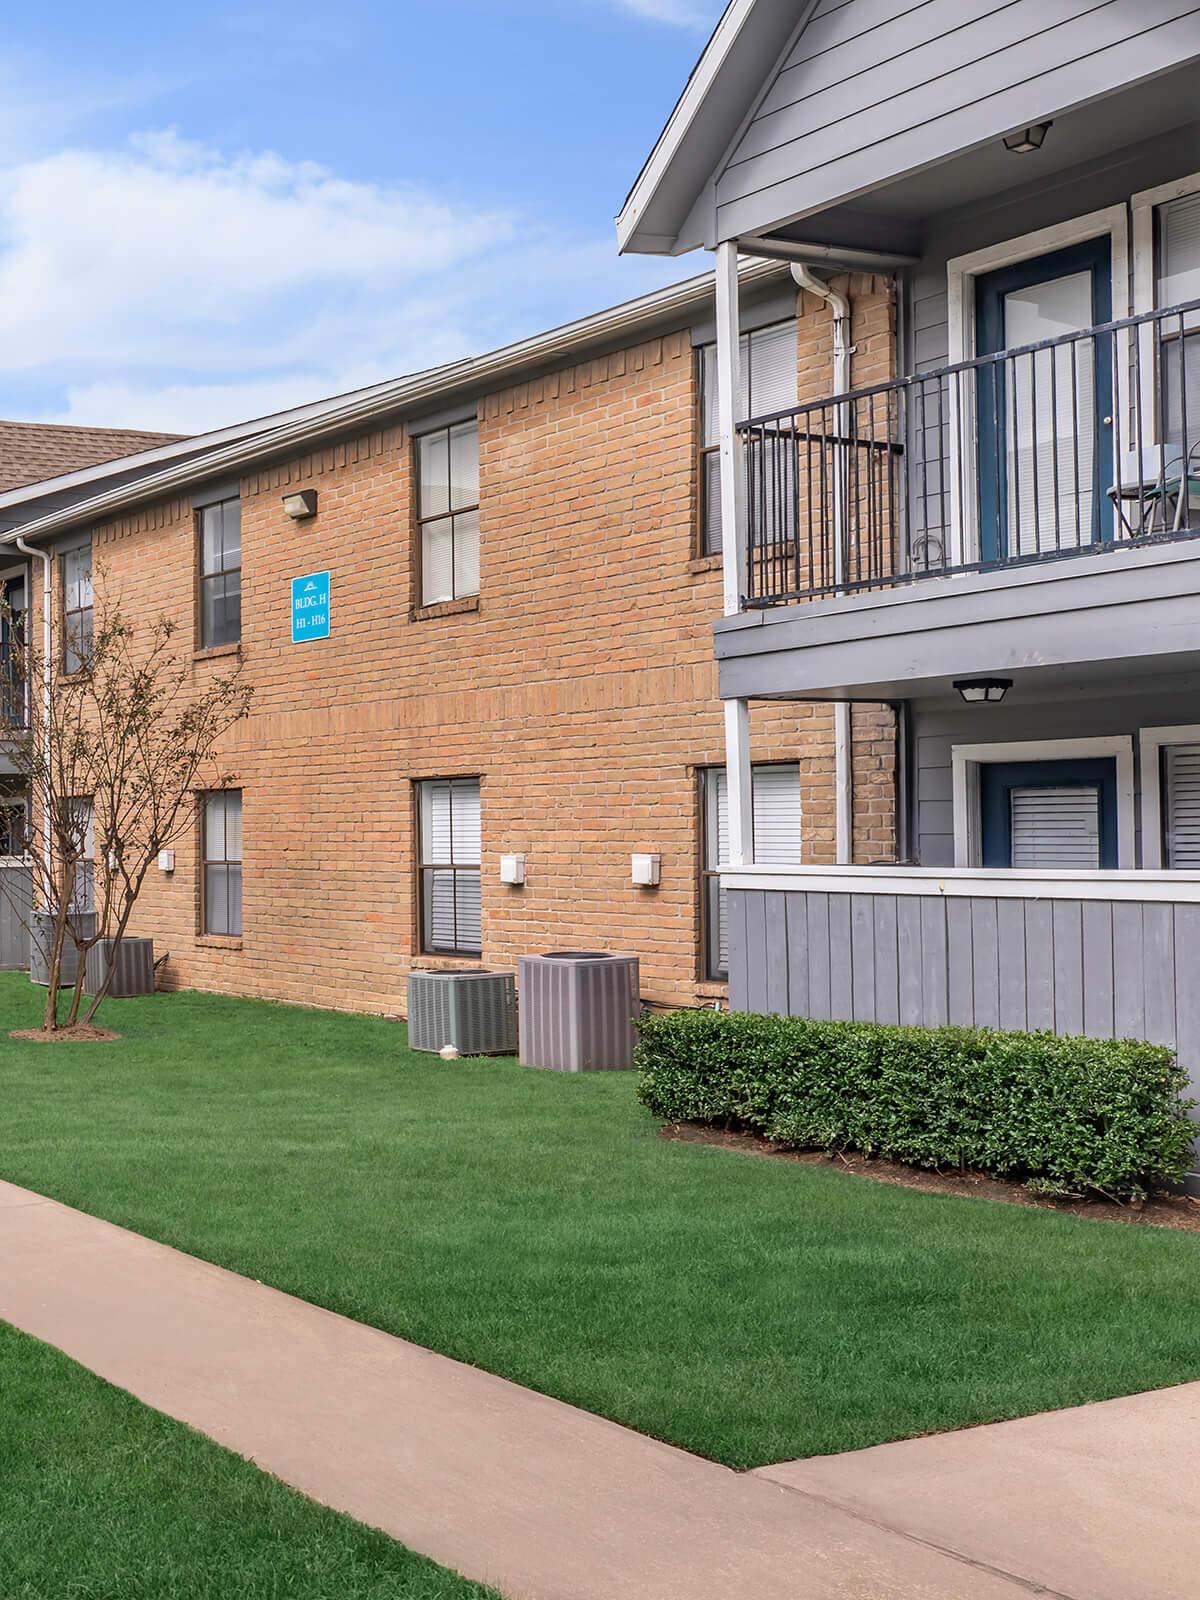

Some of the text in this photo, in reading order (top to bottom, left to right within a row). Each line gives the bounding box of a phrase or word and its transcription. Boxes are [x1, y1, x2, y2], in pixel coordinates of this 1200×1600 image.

[320, 593, 326, 605] H
[296, 618, 306, 629] H1
[312, 614, 326, 626] H16
